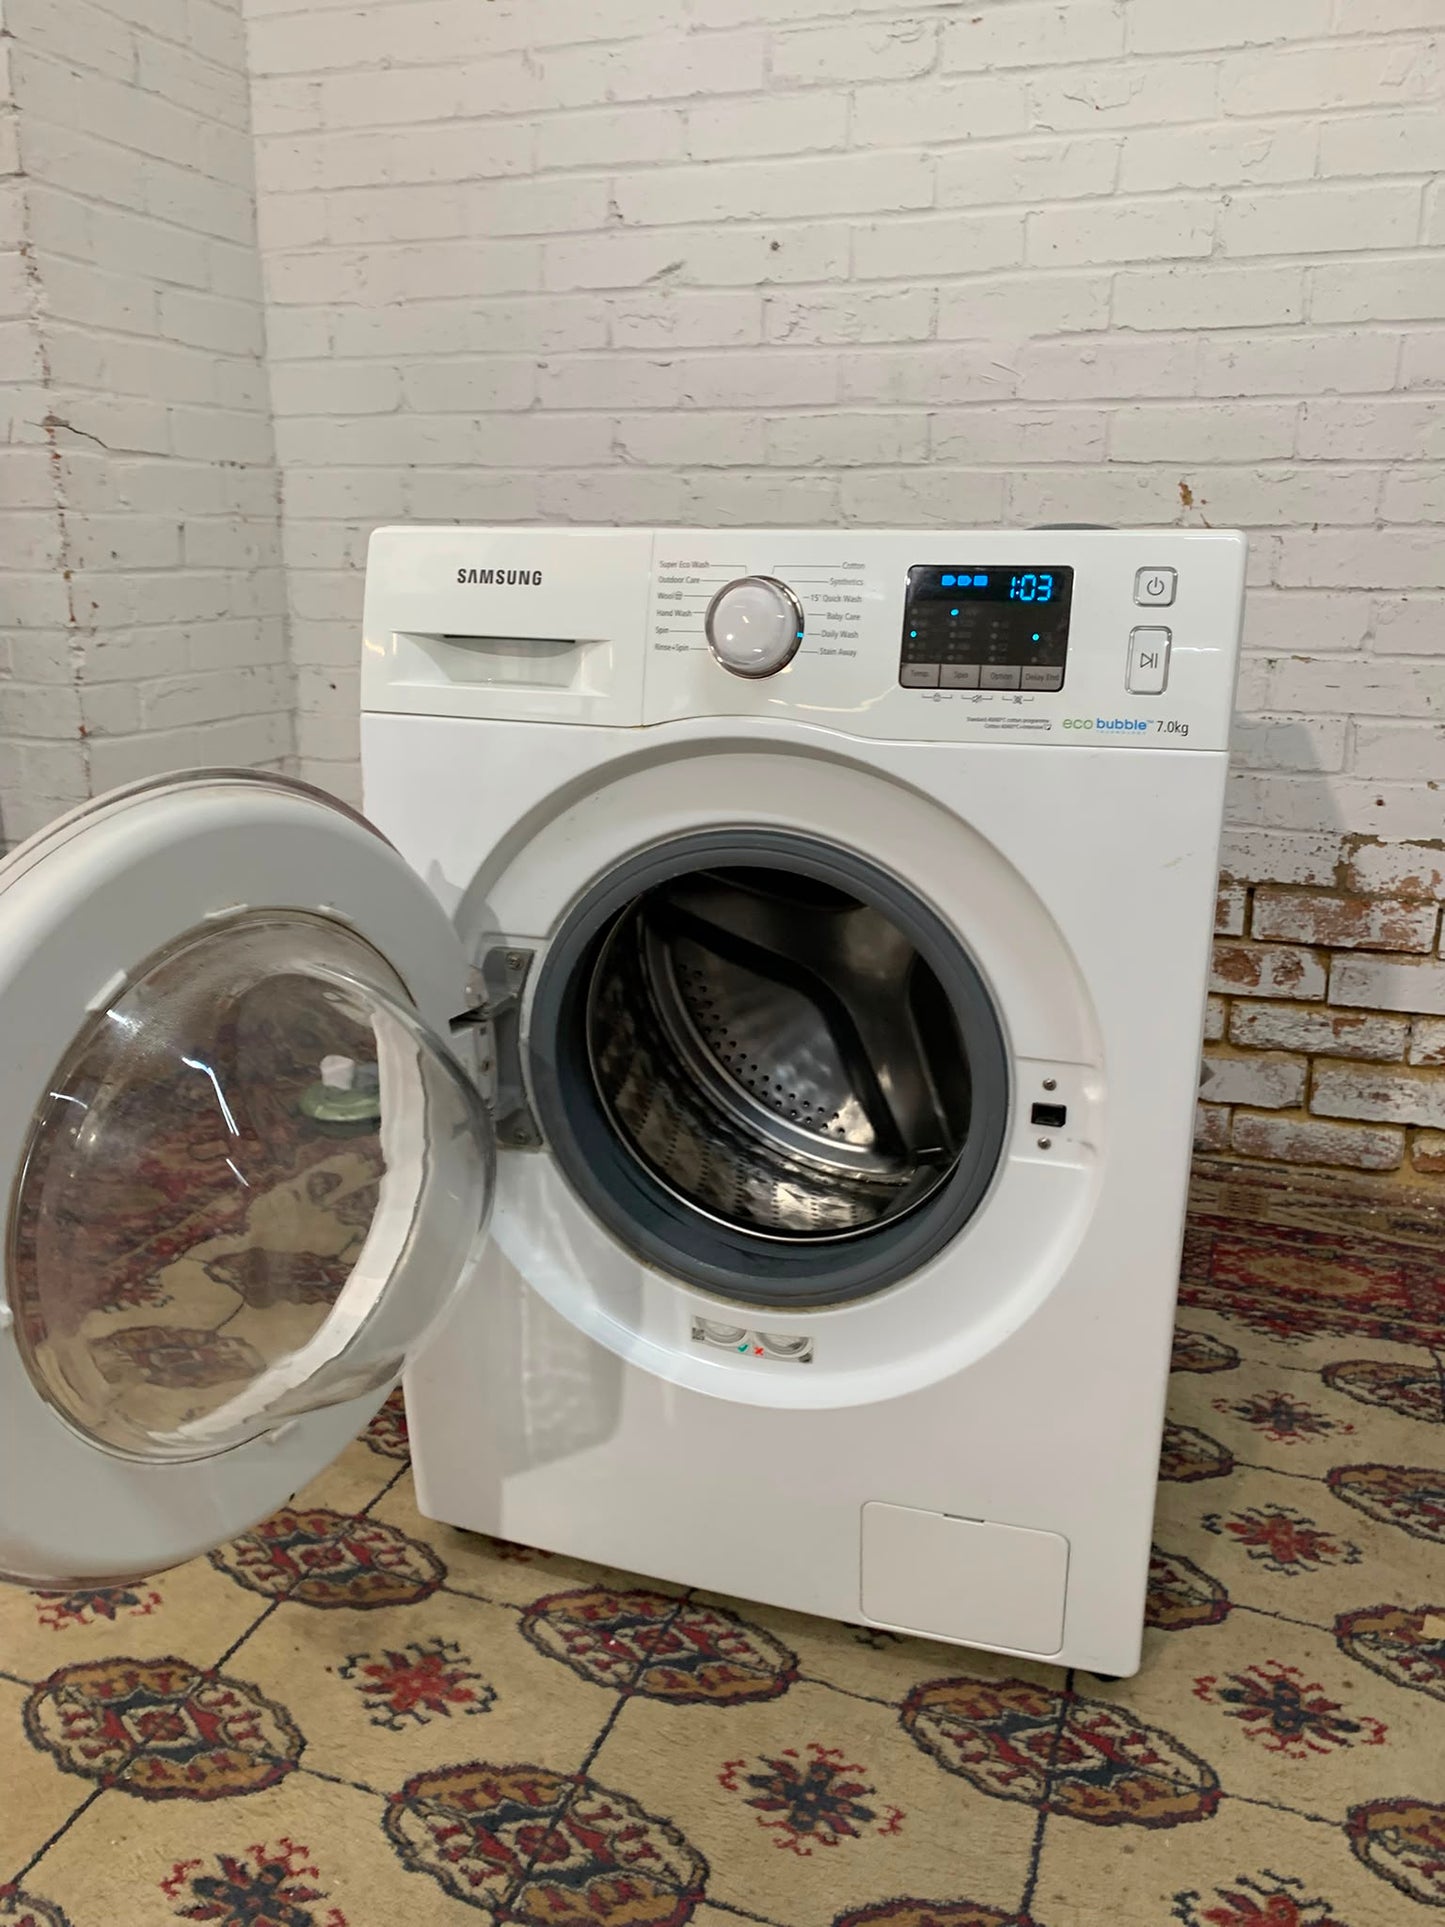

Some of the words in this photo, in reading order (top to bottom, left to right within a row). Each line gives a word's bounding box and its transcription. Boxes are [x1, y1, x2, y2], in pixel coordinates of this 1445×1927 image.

[457, 568, 542, 586] SAMSUNG
[1009, 574, 1053, 601] 1:03
[823, 594, 841, 602] Quick
[843, 595, 862, 603] Wash
[826, 612, 843, 621] Baby
[845, 612, 861, 620] Care
[821, 630, 838, 639] Daily
[840, 630, 859, 638] Wash
[1062, 718, 1094, 730] eco
[1096, 717, 1147, 731] bubble
[1156, 720, 1189, 737] 7.0kg
